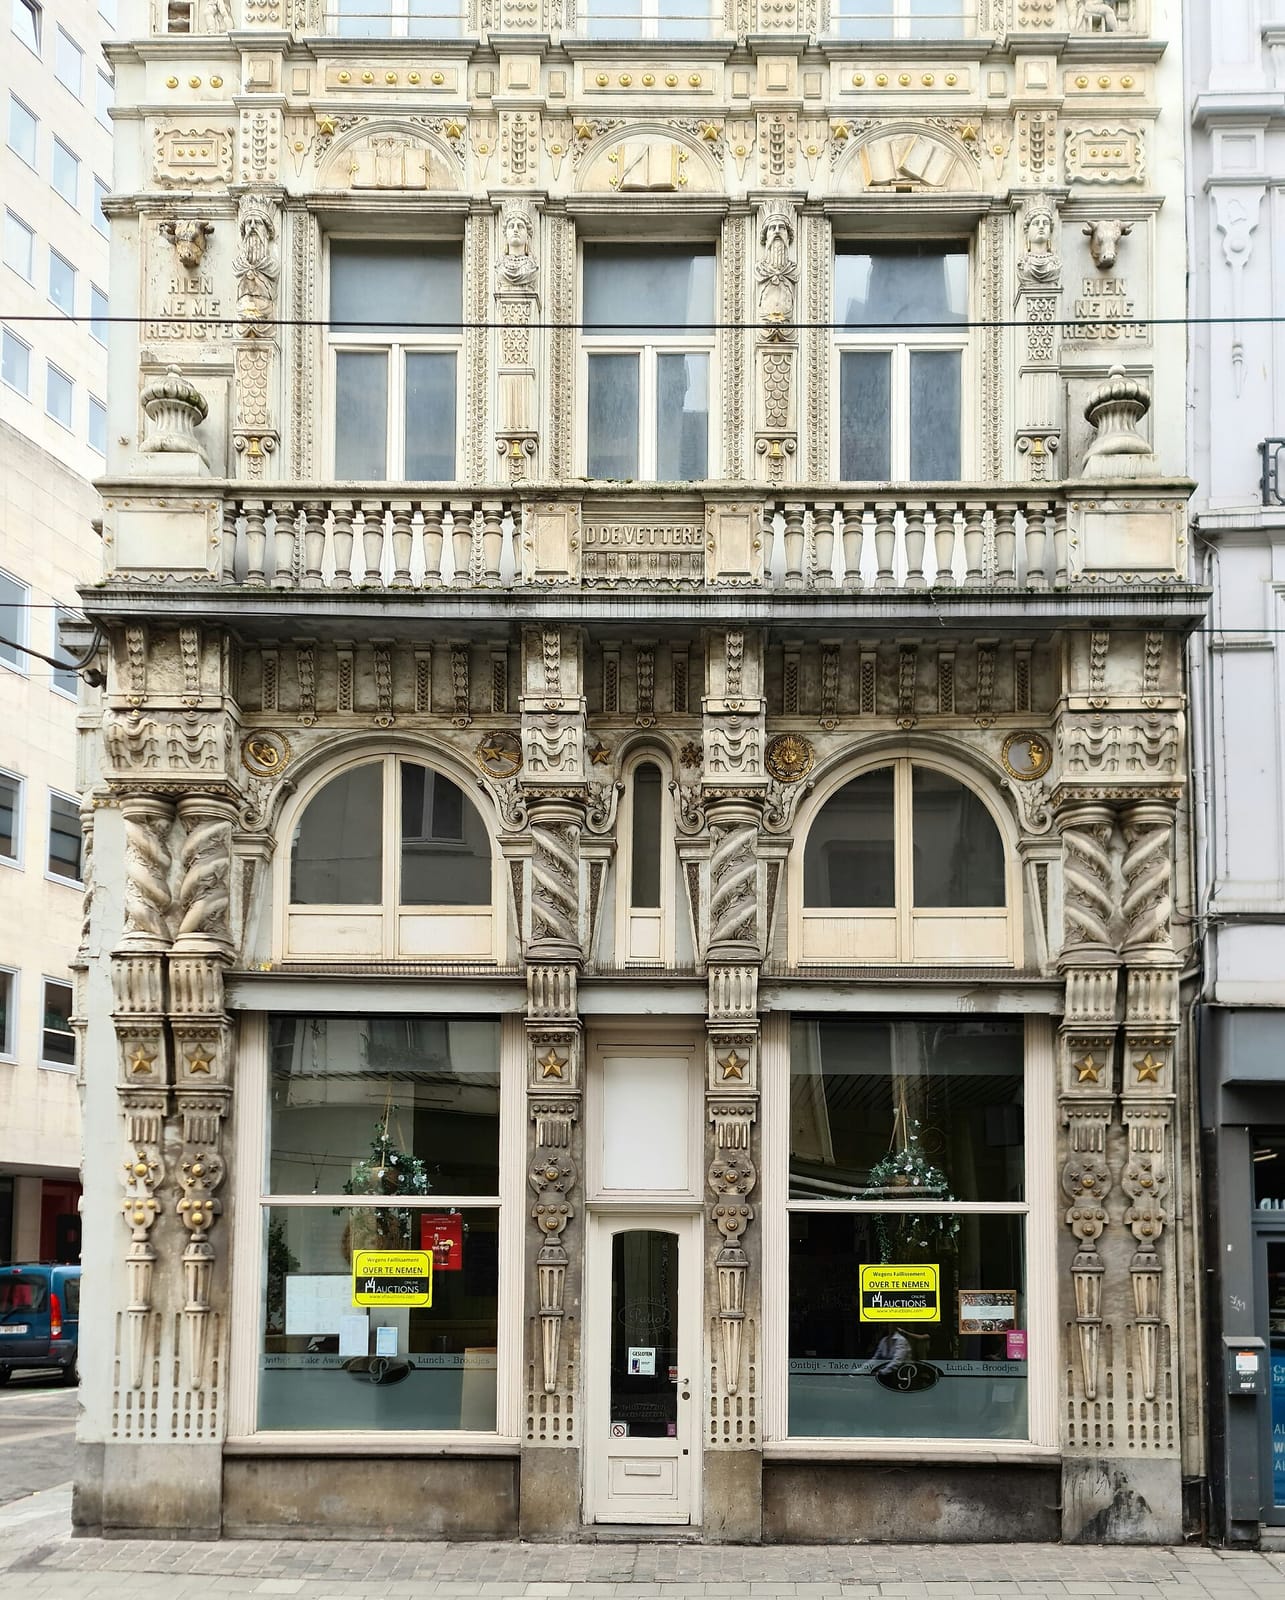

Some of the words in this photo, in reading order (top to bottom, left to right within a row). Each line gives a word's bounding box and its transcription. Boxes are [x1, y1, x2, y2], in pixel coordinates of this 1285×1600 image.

[168, 276, 213, 294] RIEN
[1082, 278, 1126, 296] RIEN
[160, 299, 186, 317] NE
[191, 298, 220, 317] ME
[1075, 300, 1100, 318] NE
[1106, 299, 1134, 318] ME
[146, 320, 234, 339] RESISTE
[1063, 321, 1146, 340] RESISTE
[376, 1285, 419, 1293] AUCTIONS
[884, 1300, 927, 1308] AUCTIONS
[418, 1356, 445, 1364] Lunch
[453, 1356, 490, 1366] Broodjes
[790, 1361, 820, 1370] Ontbijt
[829, 1361, 849, 1369] Take
[946, 1363, 973, 1371] Lunch
[982, 1364, 1019, 1373] Broodjes
